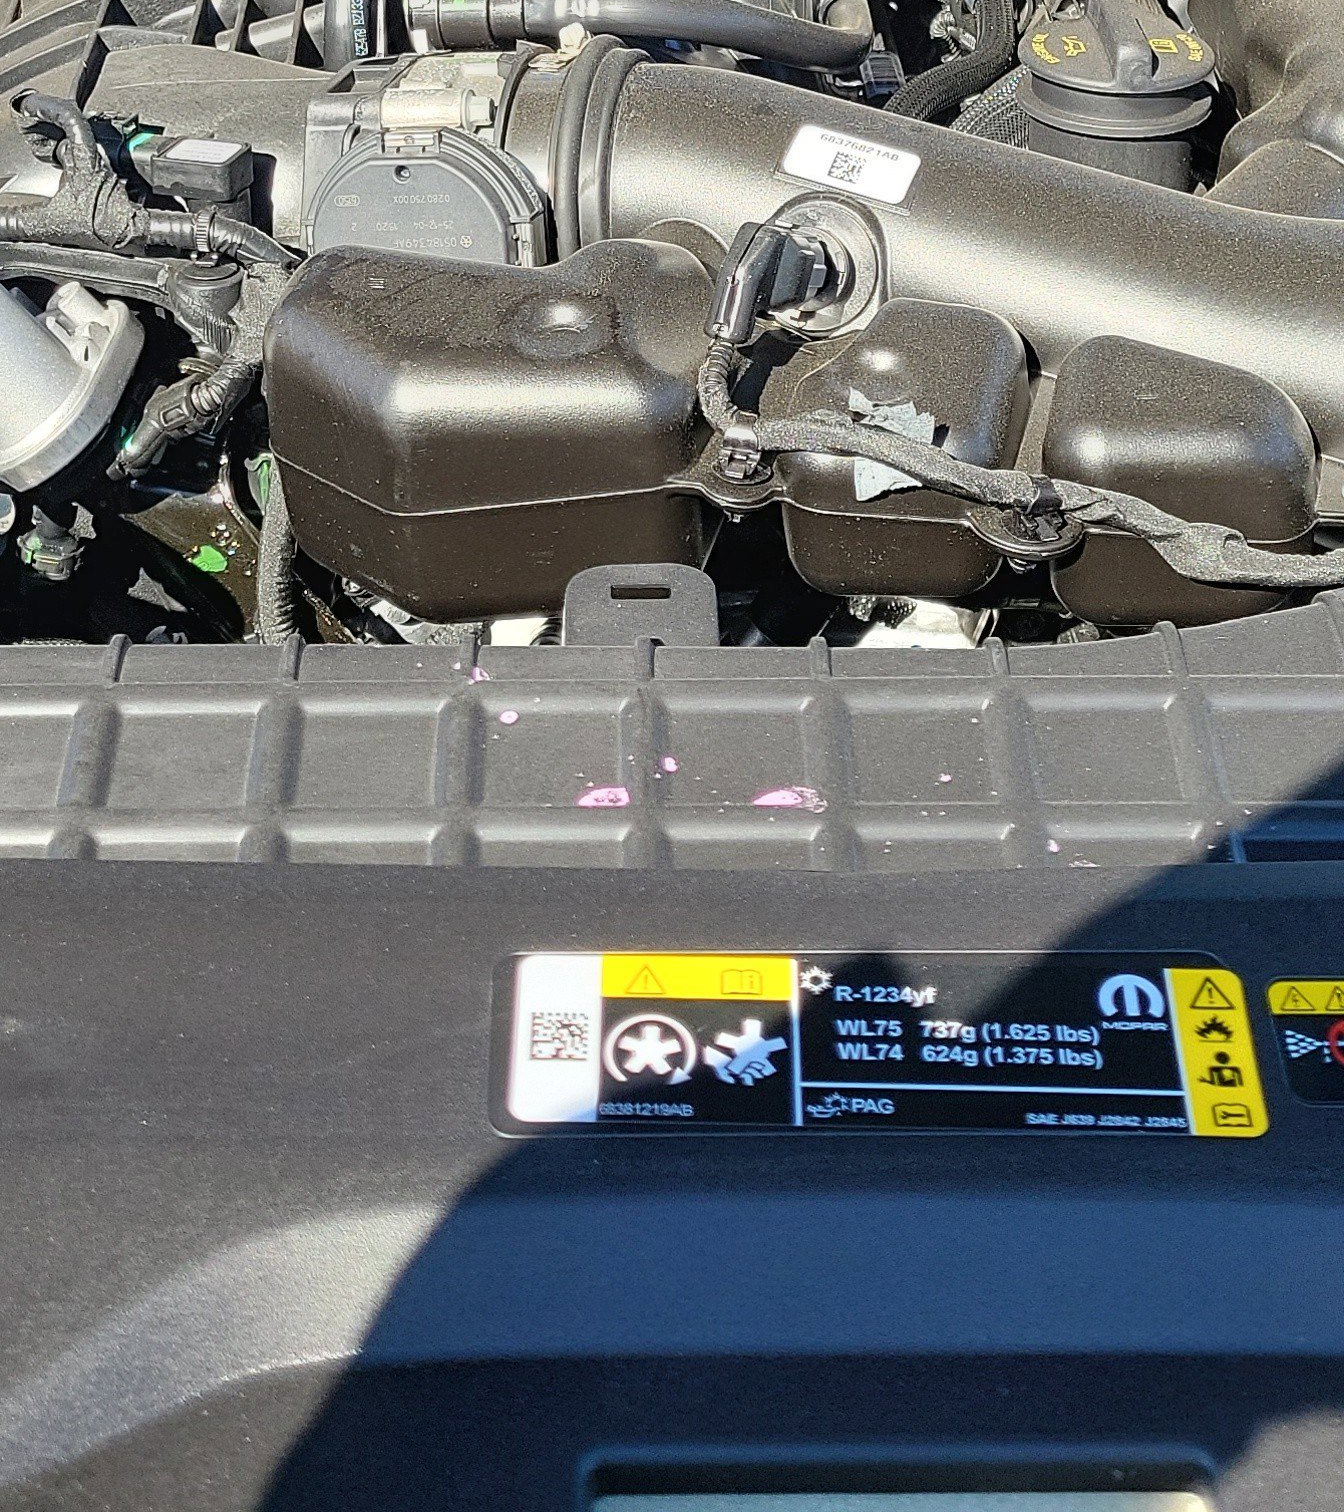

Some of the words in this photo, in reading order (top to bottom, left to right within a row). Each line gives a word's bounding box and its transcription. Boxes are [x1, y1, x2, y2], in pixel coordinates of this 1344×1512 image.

[834, 986, 938, 1008] R-1234yf
[835, 1019, 903, 1038] WL75
[918, 1020, 976, 1044] 737g
[981, 1022, 1051, 1044] (1.625
[1056, 1024, 1101, 1046] lbs)
[836, 1042, 905, 1061] WL74
[921, 1045, 979, 1067] 624g
[983, 1046, 1055, 1067] (1.375
[1058, 1047, 1104, 1070] lbs)
[851, 1098, 895, 1114] PAG
[1025, 1113, 1059, 1125] SAE
